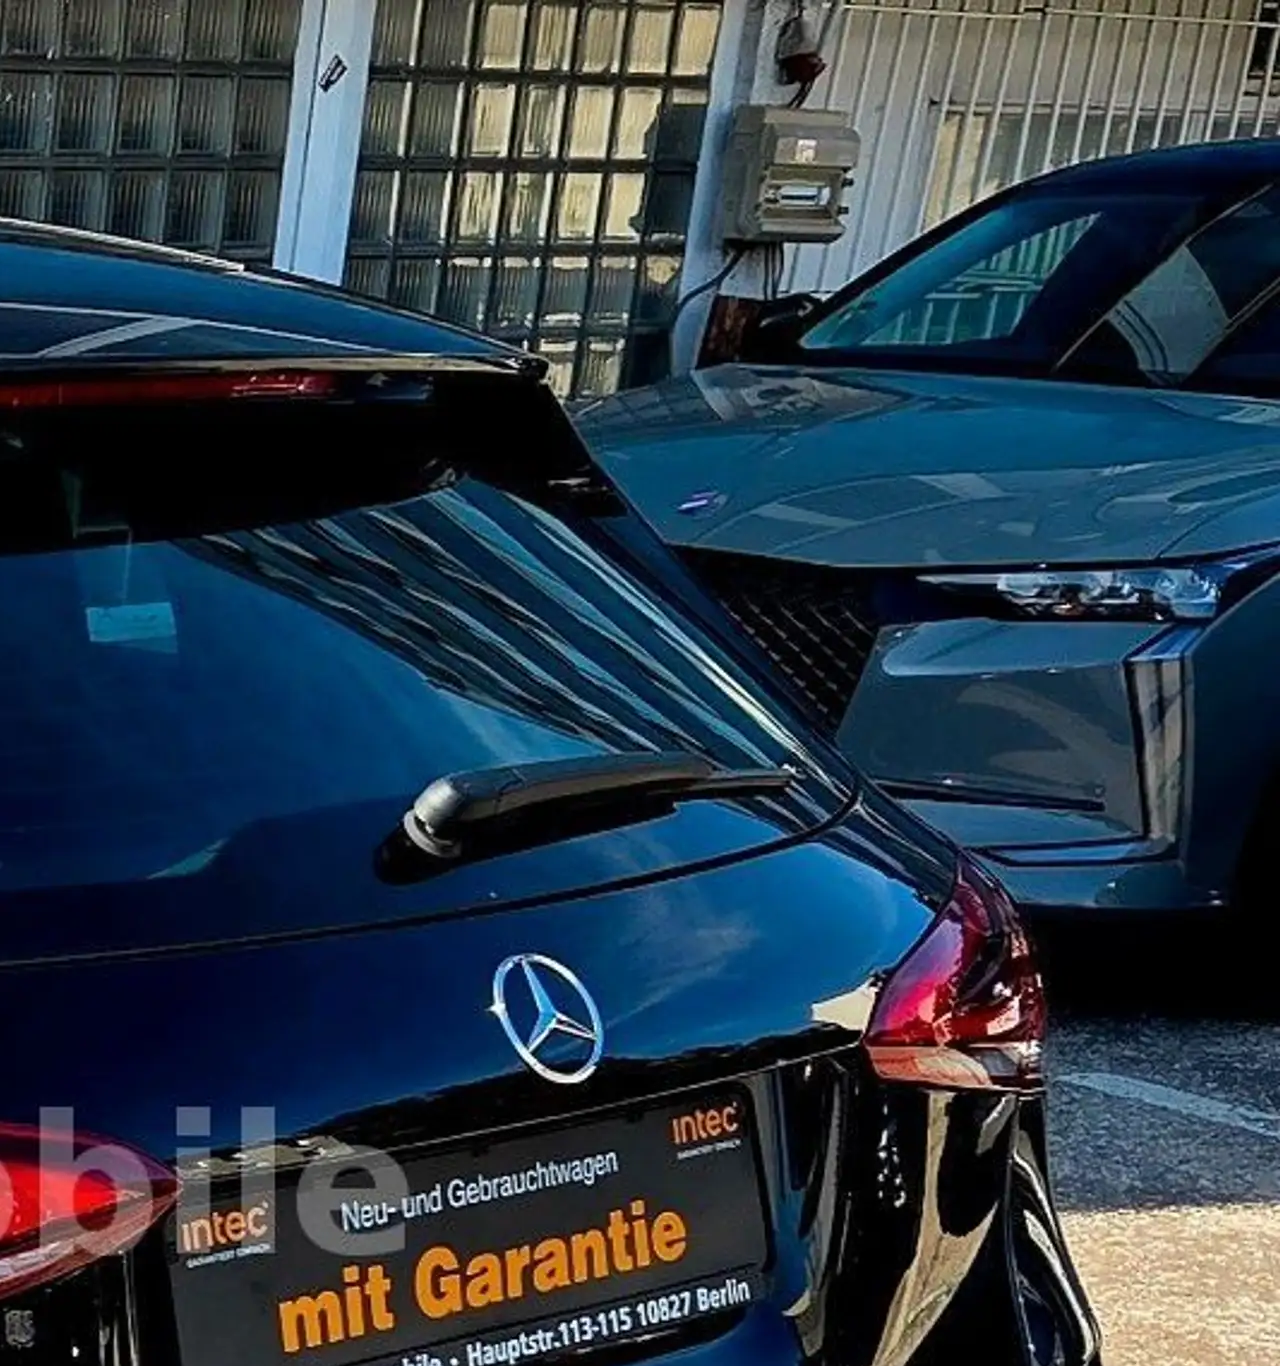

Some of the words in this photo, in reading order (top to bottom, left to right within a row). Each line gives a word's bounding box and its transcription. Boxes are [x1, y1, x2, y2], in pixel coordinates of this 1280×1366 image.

[672, 1101, 738, 1145] intec
[340, 1201, 396, 1232] Neu-
[402, 1184, 442, 1219] und
[446, 1151, 620, 1208] Gebrauchtwagen
[181, 1201, 270, 1251] intec
[278, 1263, 395, 1353] mit
[413, 1200, 688, 1320] Garantie
[637, 1291, 692, 1327] 10827
[696, 1278, 751, 1312] Berlin
